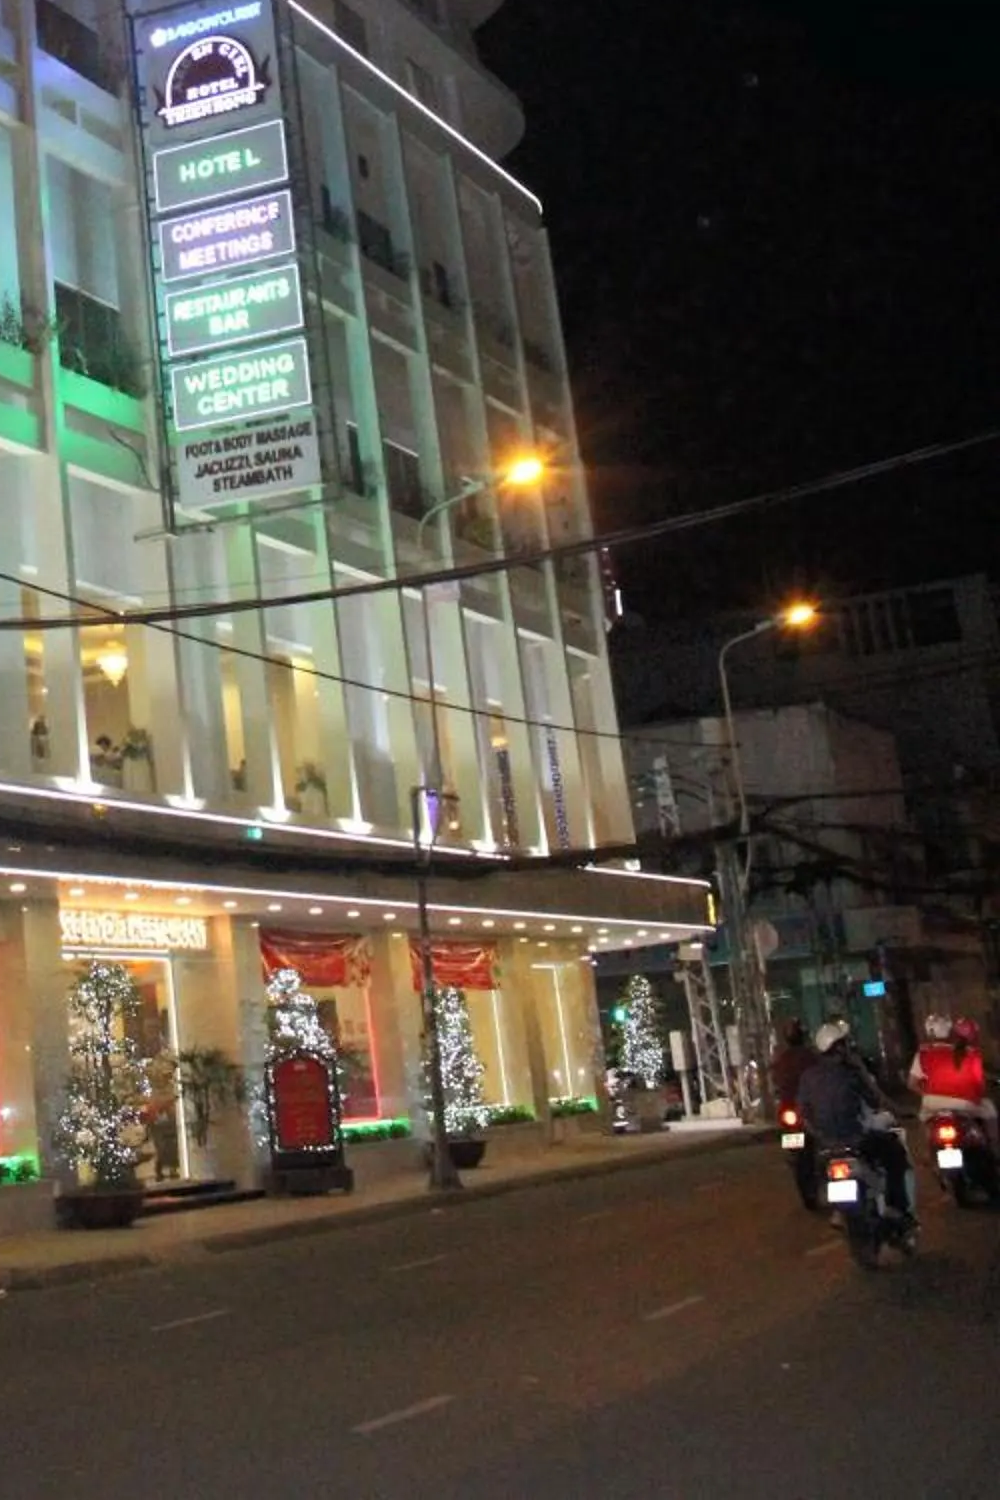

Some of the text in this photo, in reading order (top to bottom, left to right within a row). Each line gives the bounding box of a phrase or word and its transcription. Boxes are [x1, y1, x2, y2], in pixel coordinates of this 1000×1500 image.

[186, 77, 239, 101] HOTEL
[179, 147, 262, 182] HOTEL
[171, 201, 280, 243] CONFERENCE
[179, 230, 274, 270] MEETINGS
[173, 277, 290, 321] RESTAURANTS
[208, 309, 250, 336] BAR
[183, 353, 295, 395] WEDDING
[197, 377, 291, 416] CENTER
[255, 421, 313, 446] MASSAGE
[213, 465, 294, 493] STEAMBATH
